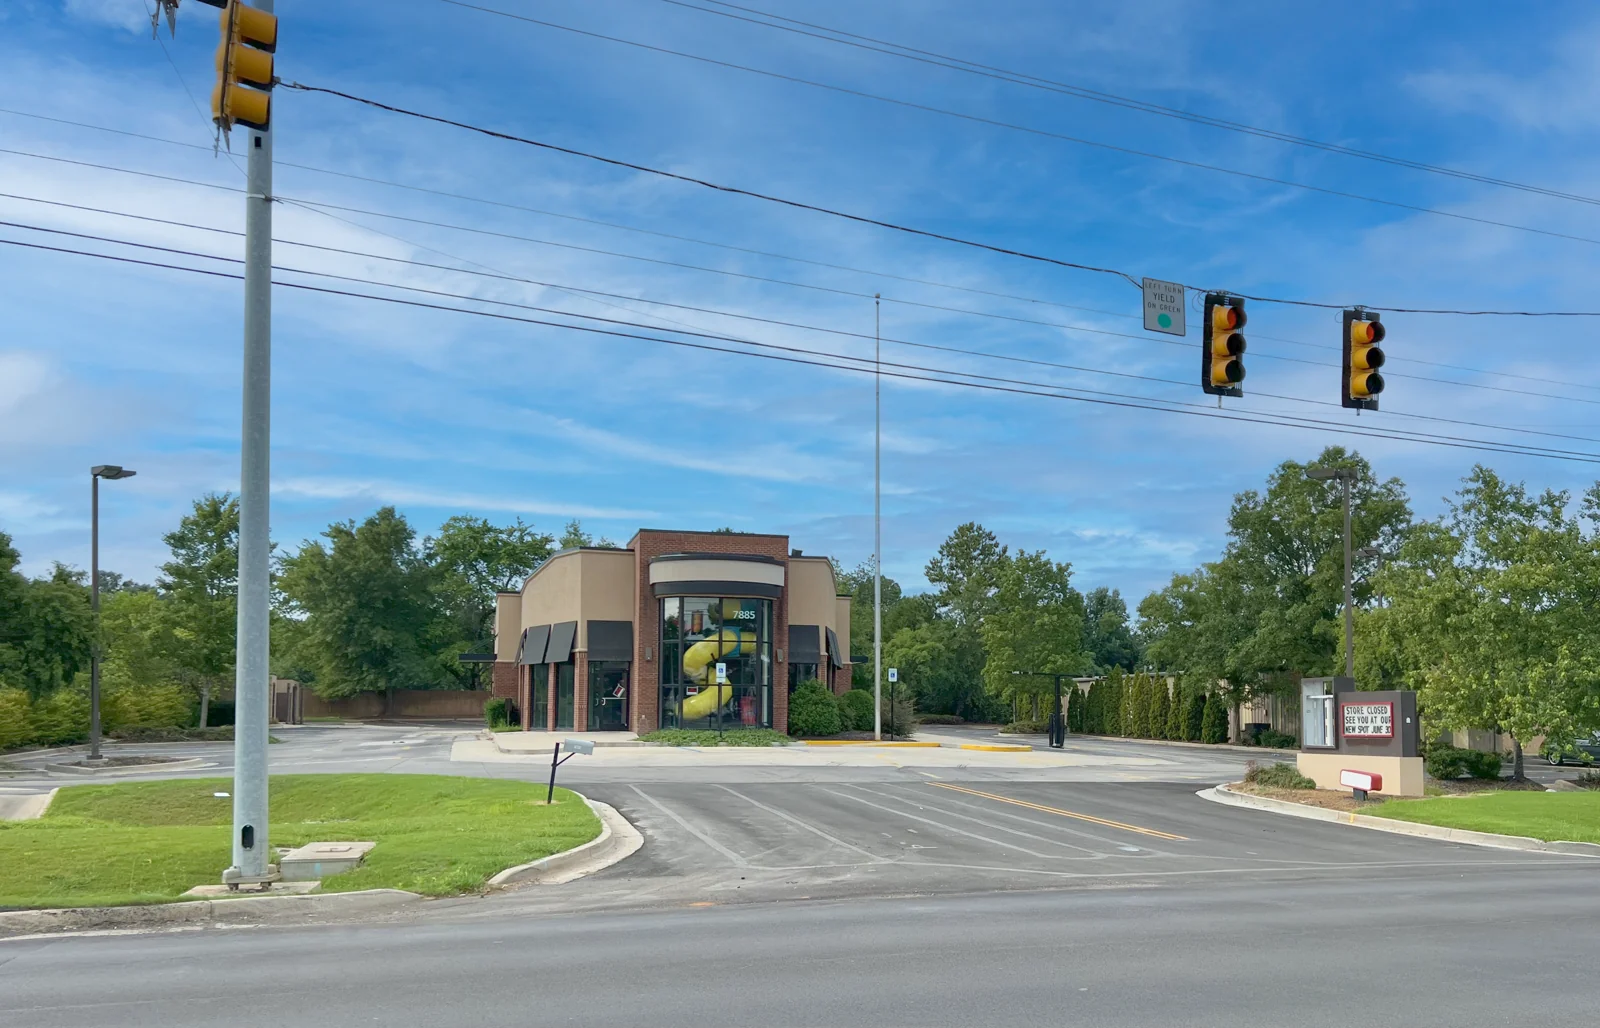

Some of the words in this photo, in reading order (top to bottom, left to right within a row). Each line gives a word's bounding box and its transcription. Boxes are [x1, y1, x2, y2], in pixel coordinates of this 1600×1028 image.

[1145, 282, 1160, 290] LEFT
[1164, 285, 1181, 294] TURN
[1153, 292, 1175, 303] YIELD
[1160, 304, 1180, 313] GREEN
[733, 611, 755, 620] 7885
[1346, 706, 1364, 715] STORE
[1367, 706, 1387, 715] CLOSED
[1345, 716, 1356, 724] SEE
[1357, 716, 1368, 724] YOU
[1370, 716, 1377, 724] AT
[1345, 725, 1356, 733] NEW
[1358, 725, 1369, 734] SPOT
[1371, 725, 1383, 734] JUNE
